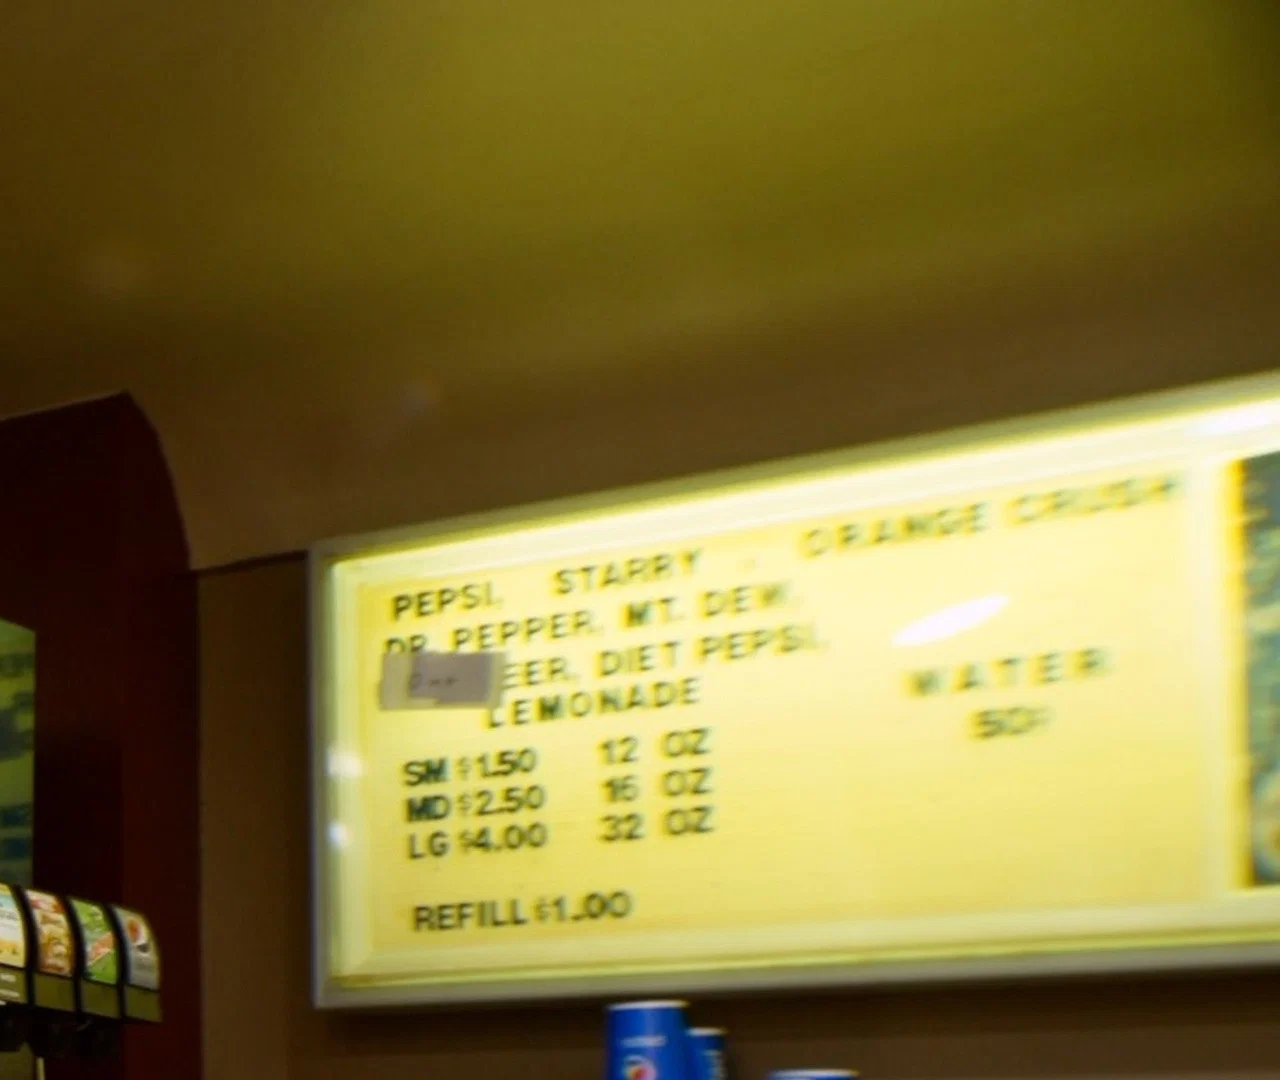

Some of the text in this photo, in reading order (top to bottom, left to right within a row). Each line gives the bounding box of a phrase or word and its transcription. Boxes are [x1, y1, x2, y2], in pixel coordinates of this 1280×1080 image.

[551, 550, 701, 597] STARRY
[799, 502, 987, 560] ORANGE
[596, 641, 682, 680] DIET
[906, 647, 1108, 697] WATER
[486, 677, 701, 729] LEMONADE
[401, 757, 448, 787] SM
[599, 736, 639, 765] 12
[660, 728, 713, 759] OZ
[403, 795, 451, 823] MD
[662, 767, 715, 797] OZ
[406, 832, 450, 860] LG
[600, 814, 645, 843] 32
[664, 806, 717, 837] OZ
[413, 902, 528, 932] REFILL
